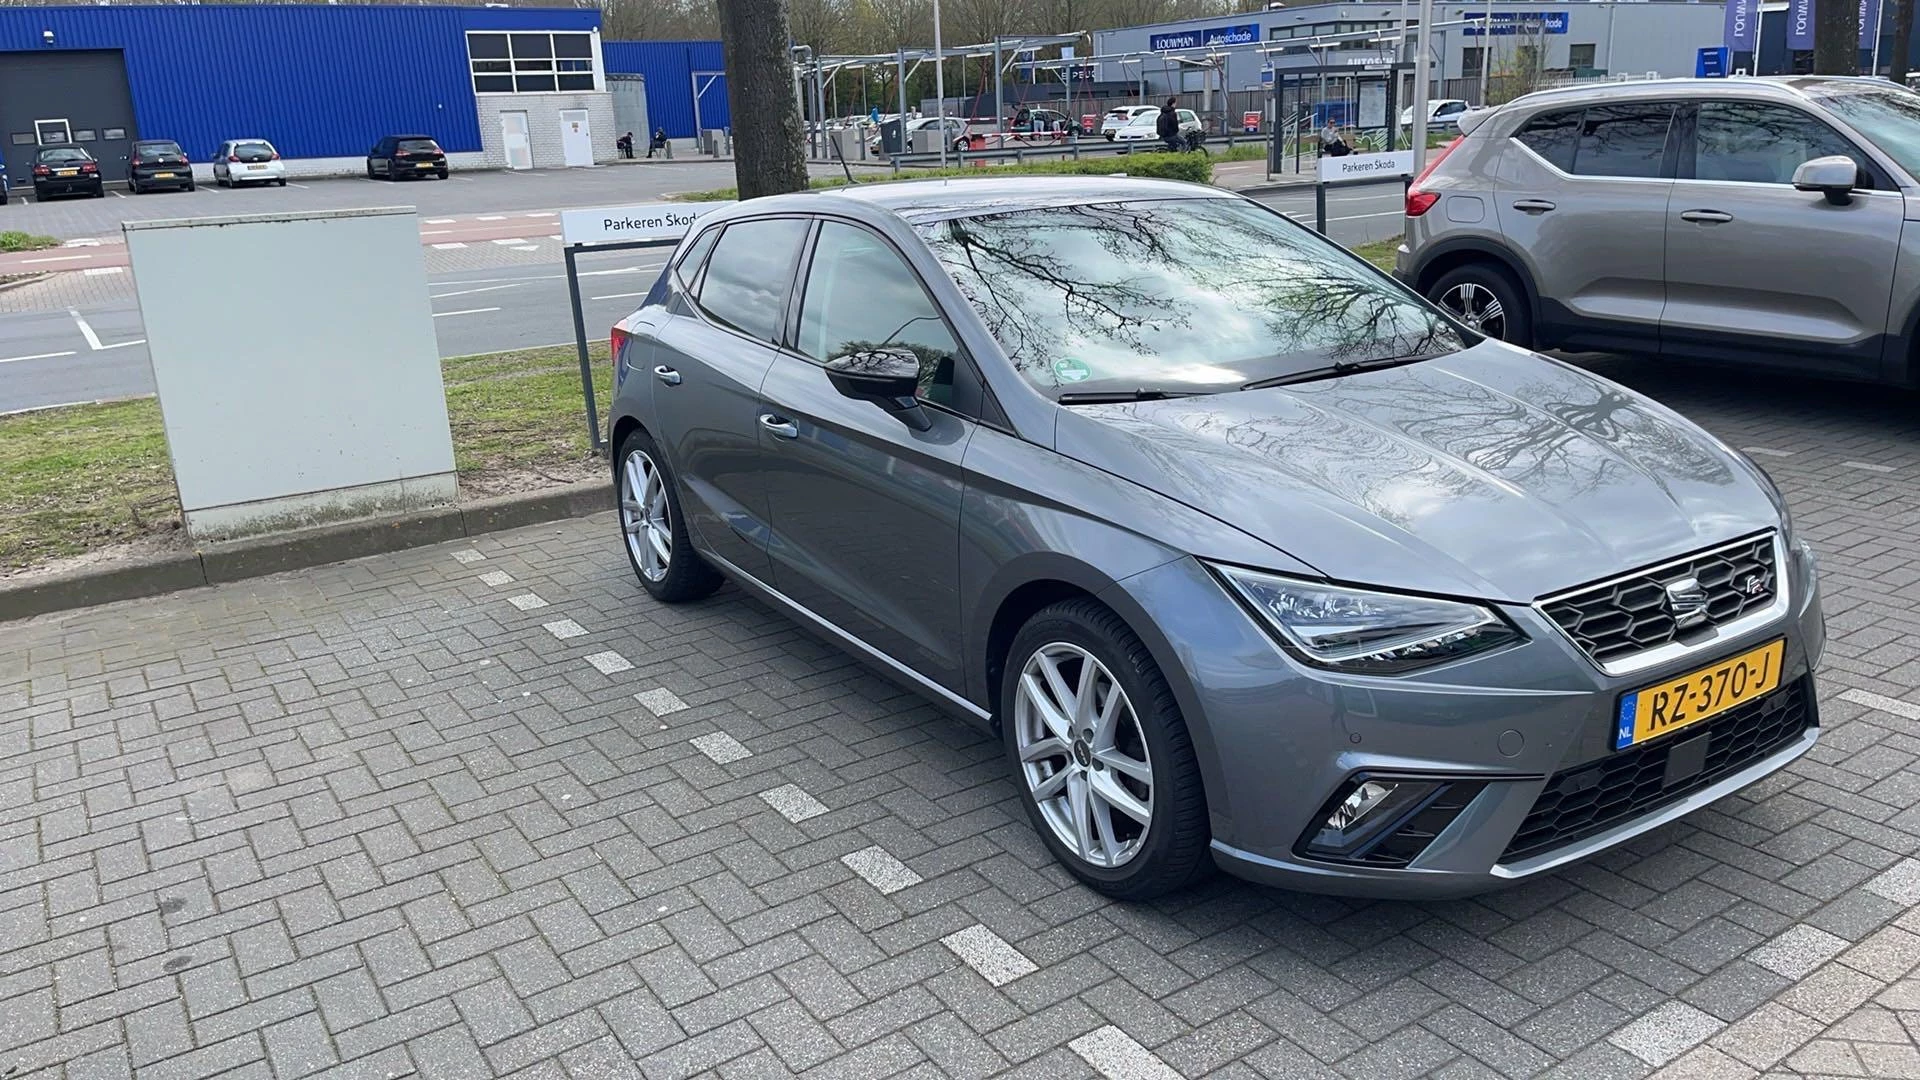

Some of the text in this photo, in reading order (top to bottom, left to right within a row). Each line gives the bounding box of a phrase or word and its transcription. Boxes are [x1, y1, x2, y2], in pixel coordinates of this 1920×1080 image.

[1156, 31, 1251, 49] LOUWMAN Autoschade
[1342, 162, 1373, 173] Parkeren
[604, 212, 697, 231] Parkeren Škod
[1650, 652, 1770, 731] RZ-370-J
[1618, 726, 1632, 740] NL
